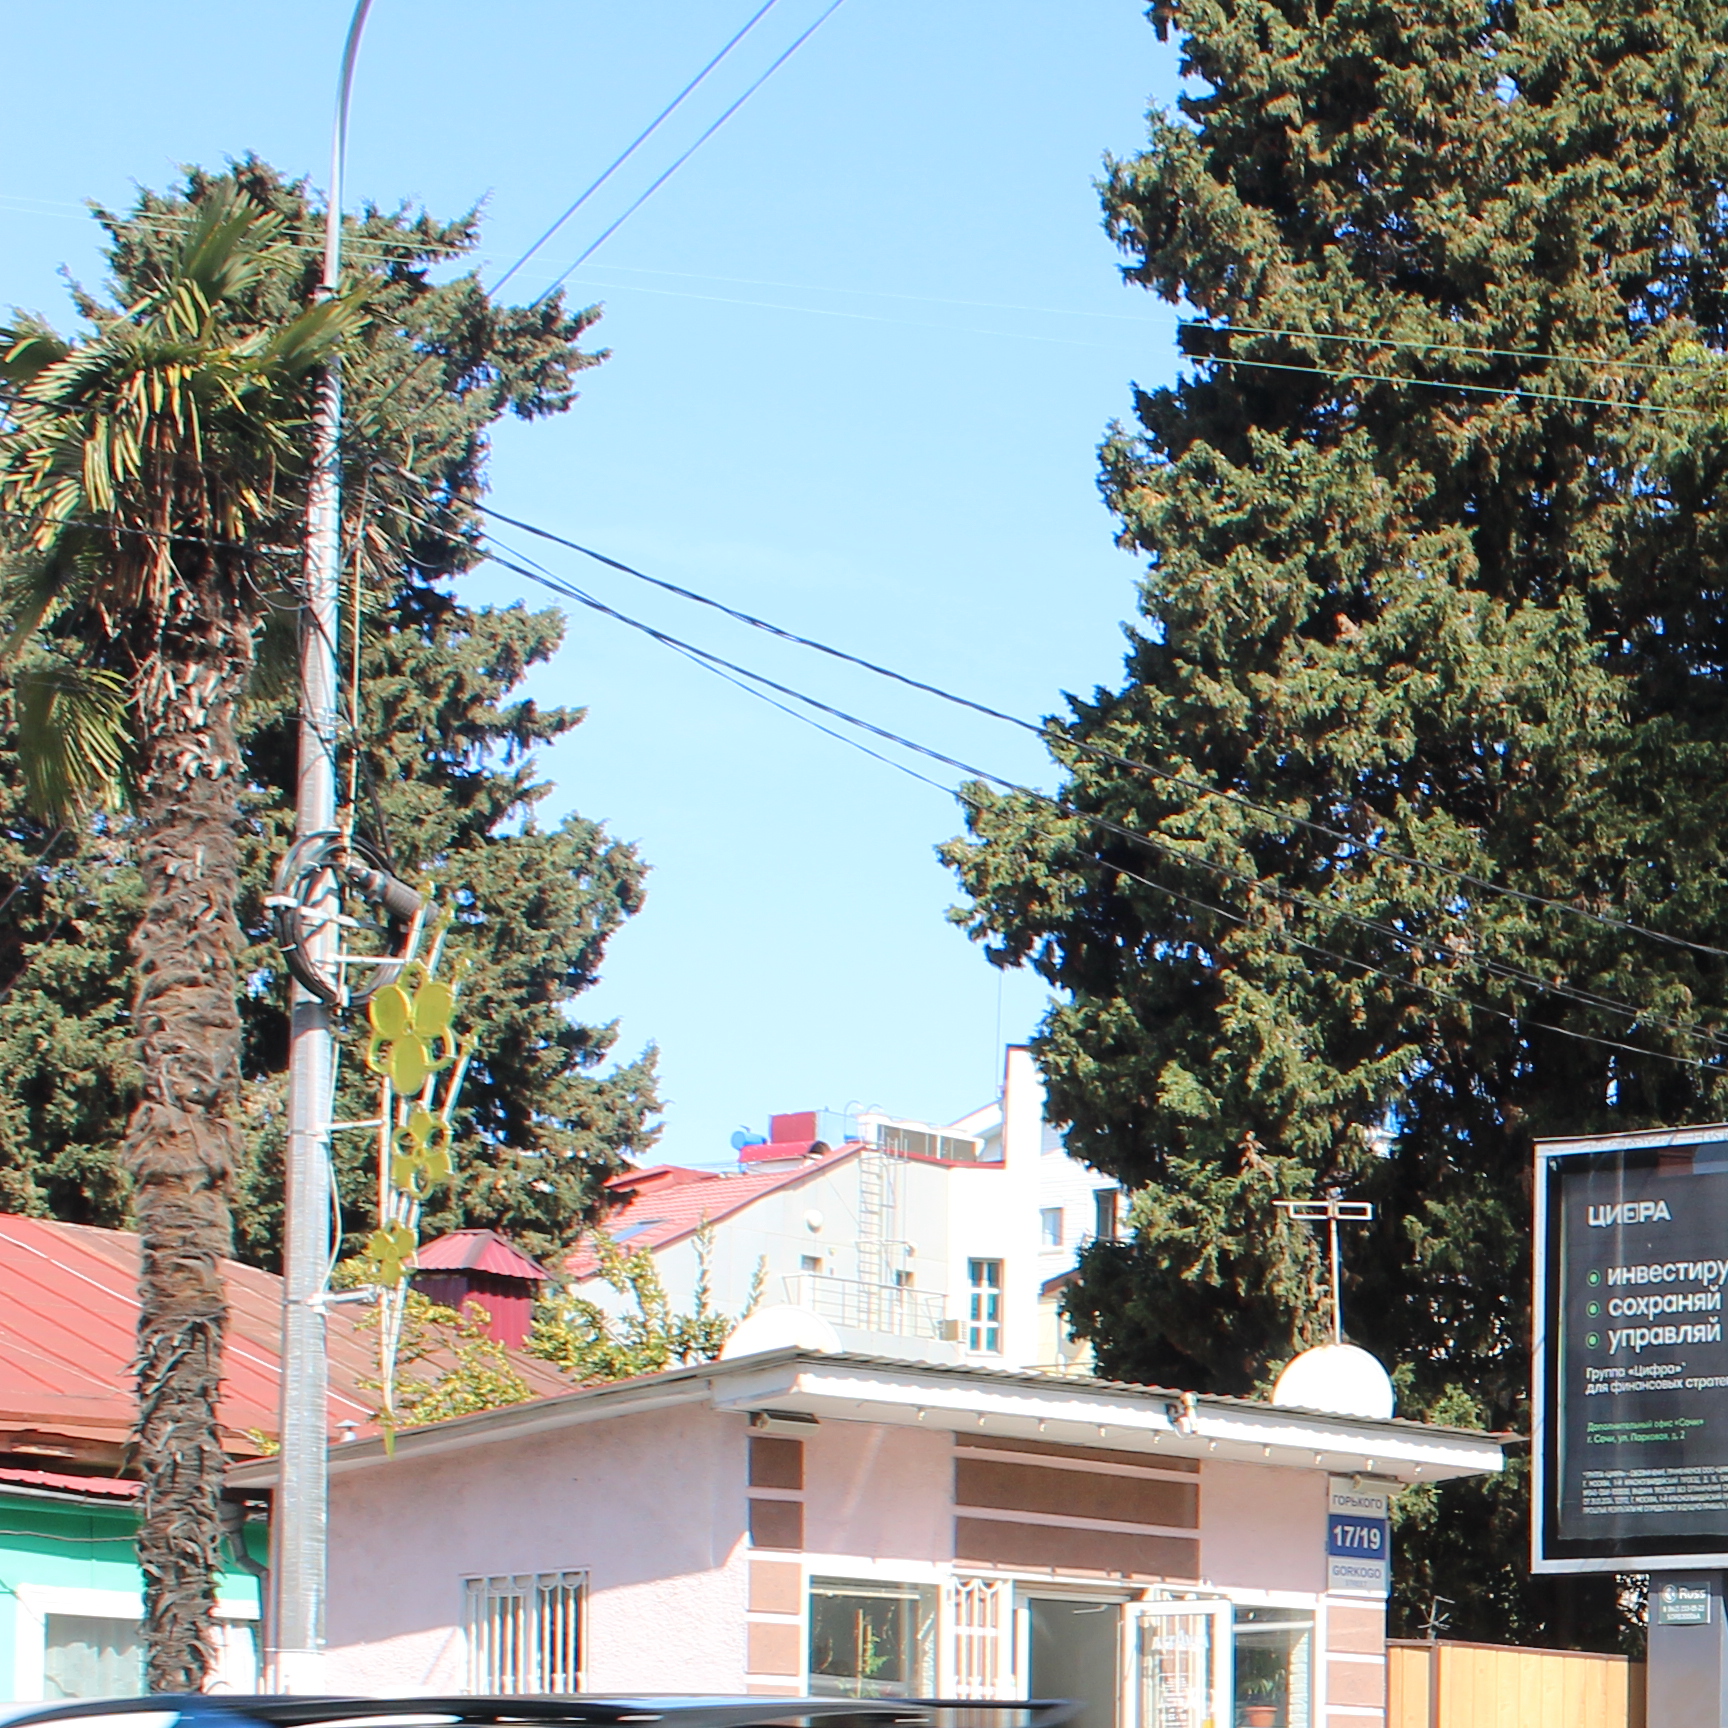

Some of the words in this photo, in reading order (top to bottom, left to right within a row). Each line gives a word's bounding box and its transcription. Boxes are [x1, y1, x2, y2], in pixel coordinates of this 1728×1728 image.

[1608, 1284, 1722, 1321] сохраняй
[1607, 1316, 1722, 1355] управляй
[1585, 1366, 1627, 1382] Группа
[1584, 1382, 1609, 1396] для
[1610, 1379, 1684, 1396] финансовых
[1332, 1494, 1383, 1510] ГОРЬКОГО
[1333, 1525, 1381, 1550] 17/19
[1332, 1565, 1381, 1580] GORKOGO
[1678, 1586, 1707, 1599] Russ
